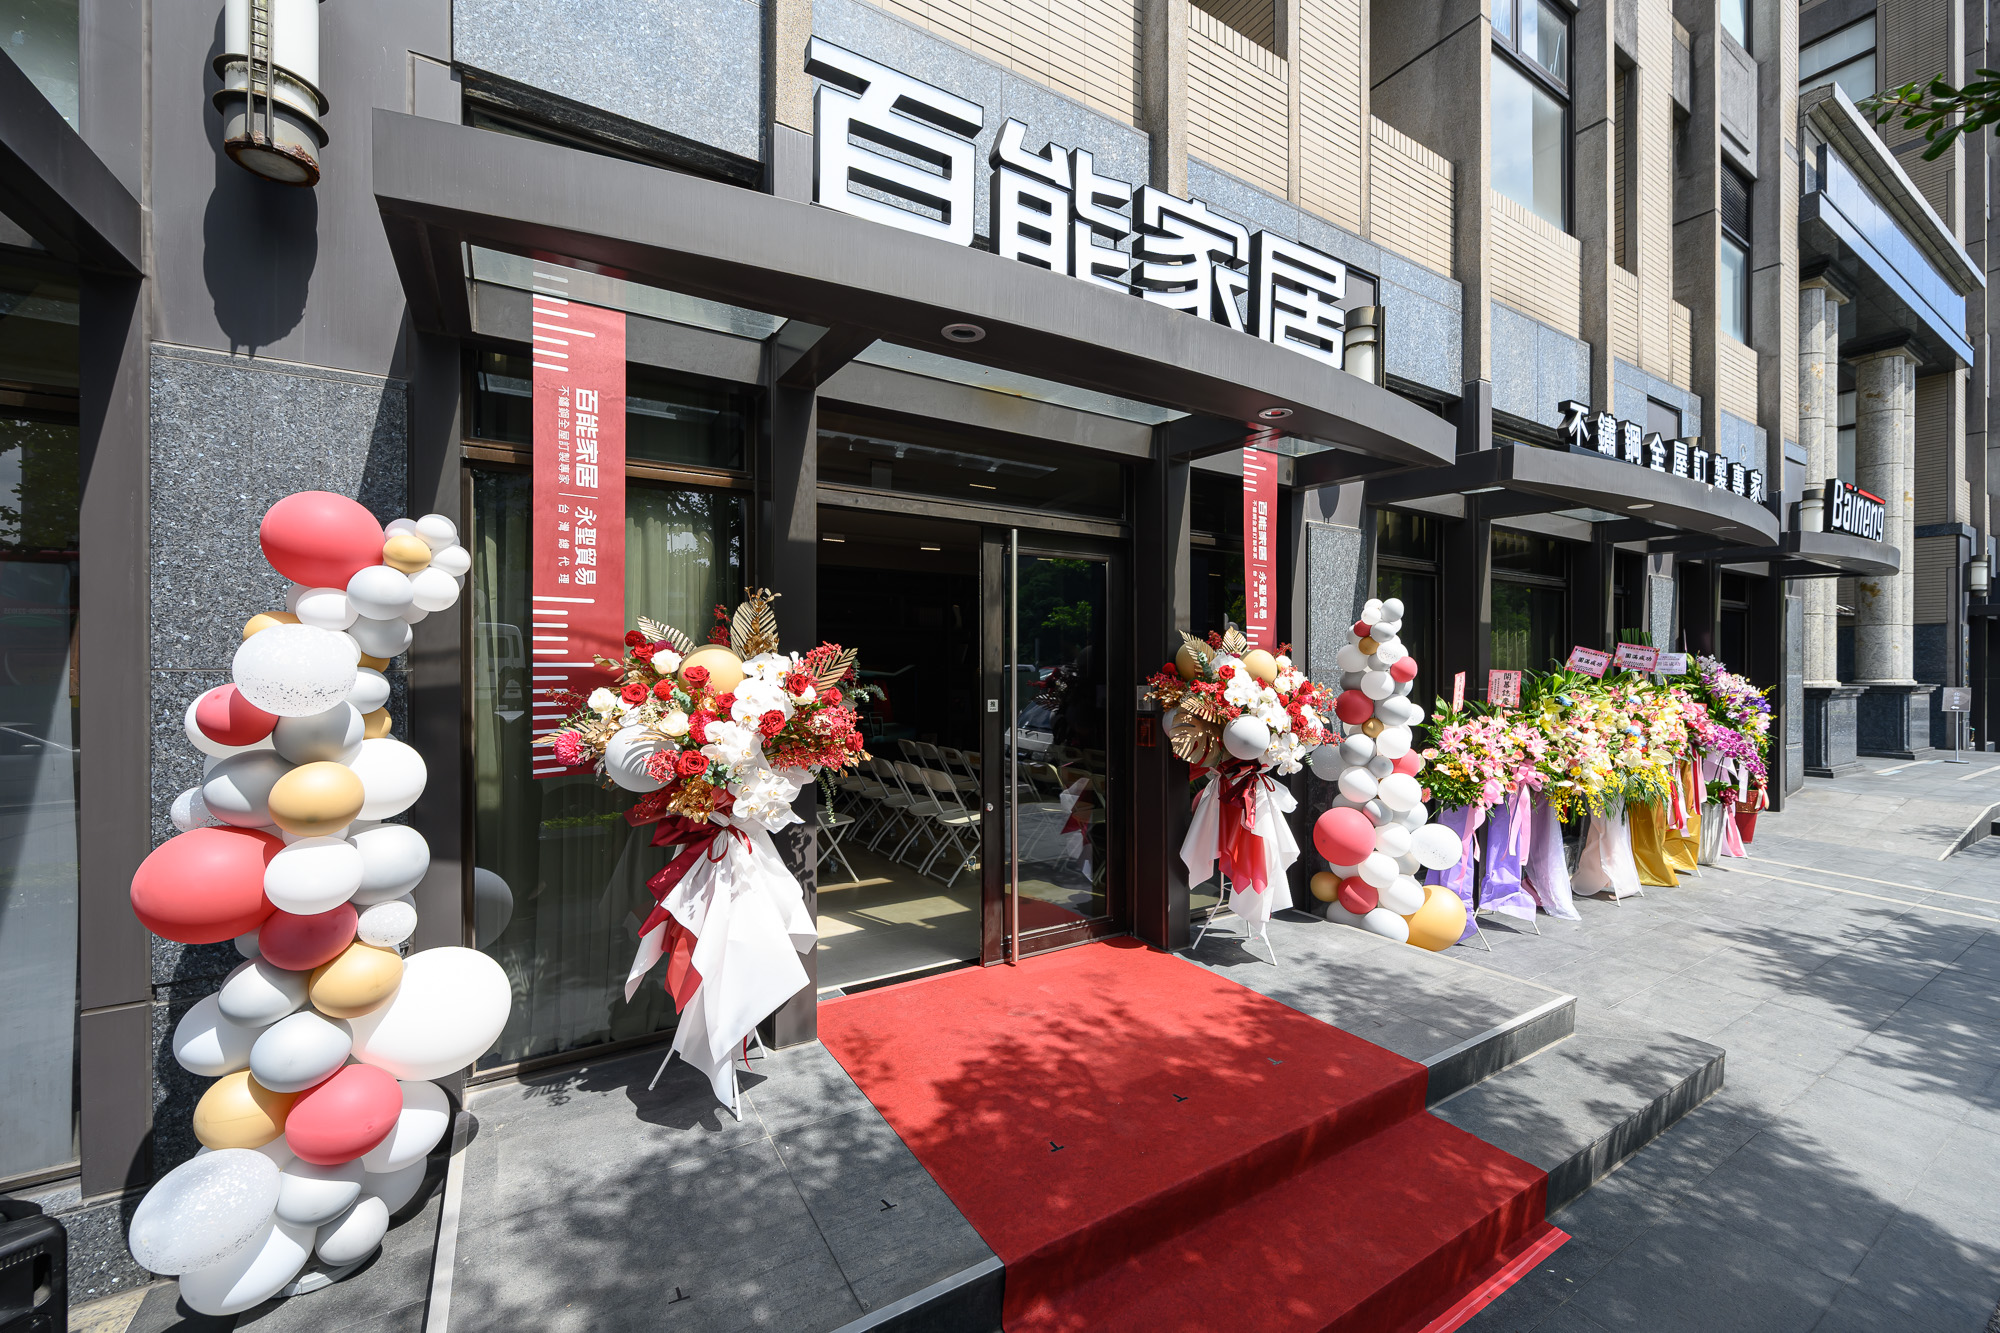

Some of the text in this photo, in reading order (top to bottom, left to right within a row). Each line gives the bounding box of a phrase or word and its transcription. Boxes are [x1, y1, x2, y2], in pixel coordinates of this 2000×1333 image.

[805, 35, 1346, 370] 百能家居
[574, 388, 599, 586] 百能家居 永聖貿易
[1563, 401, 1763, 504] 不鏽鋼全屋訂製專家
[558, 503, 570, 585] 台灣總代理
[1832, 478, 1885, 543] Baineng
